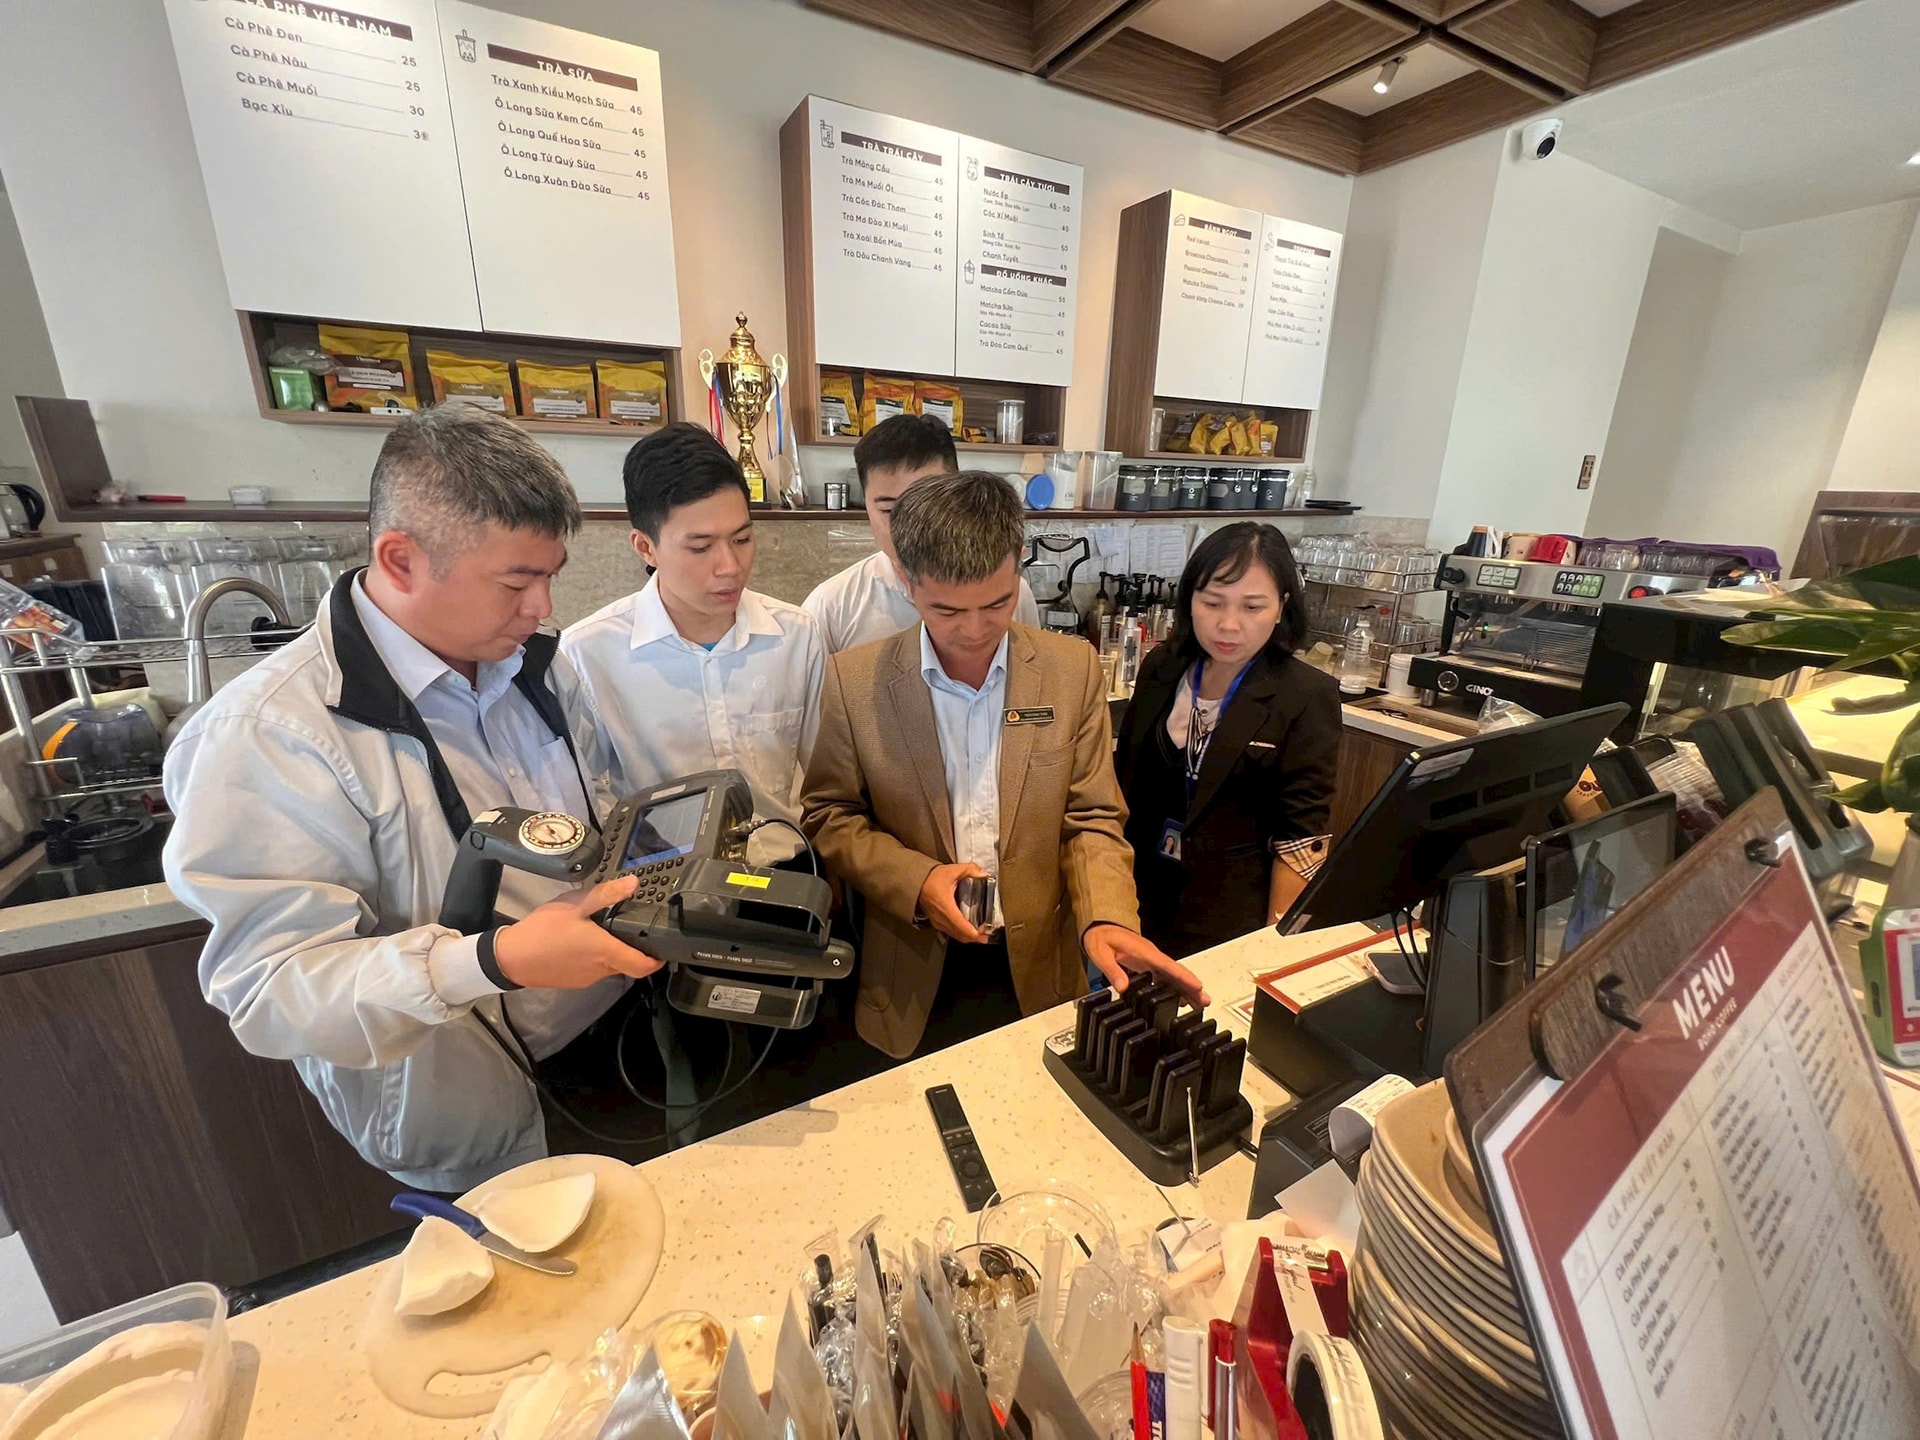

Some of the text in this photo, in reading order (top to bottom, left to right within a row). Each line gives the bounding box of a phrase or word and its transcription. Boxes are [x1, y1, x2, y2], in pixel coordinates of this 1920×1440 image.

[273, 0, 307, 17] PHÊ
[356, 22, 392, 37] NAM
[224, 17, 417, 67] Cà Phê Đen 25
[230, 44, 421, 92] Cà Phê Nâu 25
[537, 61, 595, 82] TRÀ SỮA
[236, 72, 425, 117] Cà Phê Muối 30
[242, 98, 268, 113] Bạc
[492, 74, 510, 87] Trà
[513, 80, 539, 93] Xanh
[566, 90, 594, 105] Mạch
[596, 96, 615, 110] Sữa
[630, 105, 643, 116] 45
[495, 96, 645, 137] Ô Long Sữa Kem Cốm 45
[498, 120, 647, 159] Ô Long Quế Hoa Sữa 45
[862, 140, 881, 152] TRÀ
[501, 144, 510, 155] Ô
[512, 148, 538, 162] Long
[554, 155, 575, 168] Quý
[577, 159, 596, 171] Sữa
[636, 170, 649, 180] 45
[842, 156, 854, 166] Trà
[504, 166, 650, 201] Ô Long Xuân Đào Sữa 45
[842, 174, 854, 185] Trà
[842, 194, 854, 203] Trà
[934, 213, 943, 221] 45
[842, 212, 854, 221] Trà
[934, 230, 943, 238] 45
[842, 230, 855, 240] Trà
[842, 248, 855, 257] Trà
[871, 254, 894, 264] Chanh
[934, 264, 943, 272] 45
[1672, 945, 1735, 1040] MENU
[1715, 997, 1738, 1029] COFFEE
